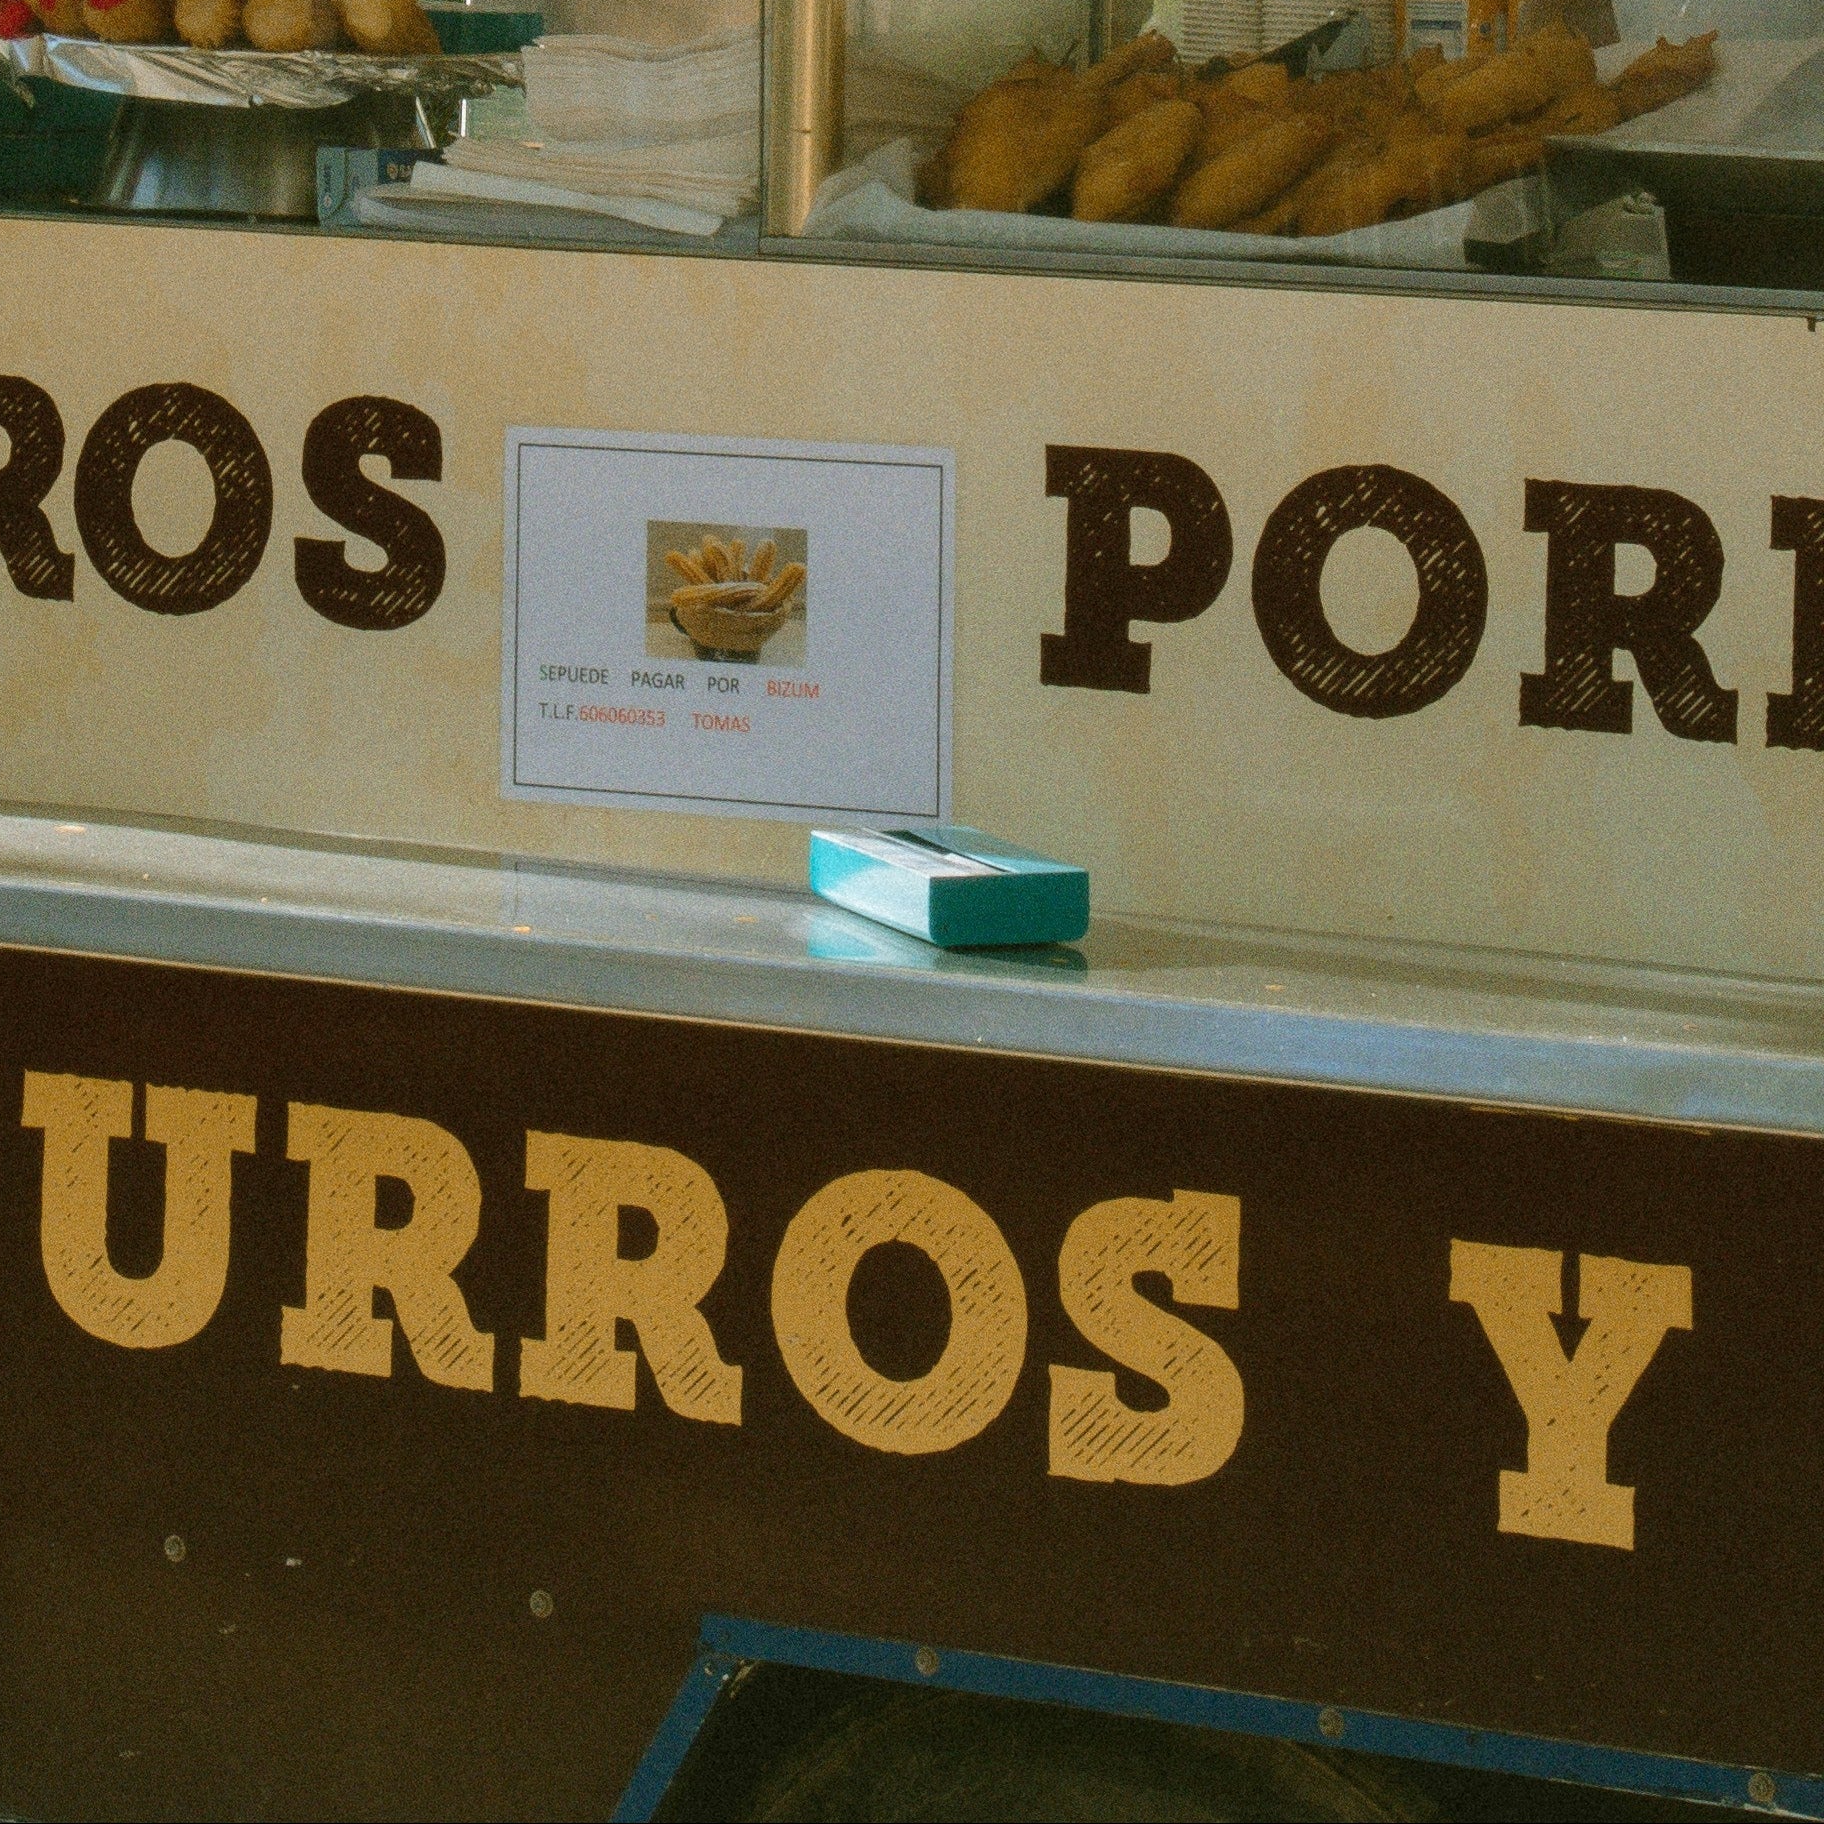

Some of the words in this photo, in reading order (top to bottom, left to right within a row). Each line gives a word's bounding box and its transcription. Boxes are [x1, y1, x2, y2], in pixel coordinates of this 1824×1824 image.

[539, 665, 609, 685] SEPUEDE
[631, 670, 686, 691] PAGAR
[707, 675, 740, 695] POR
[766, 679, 821, 699] BIZUM
[692, 711, 752, 733] TOMAS
[1449, 1240, 1694, 1552] Y
